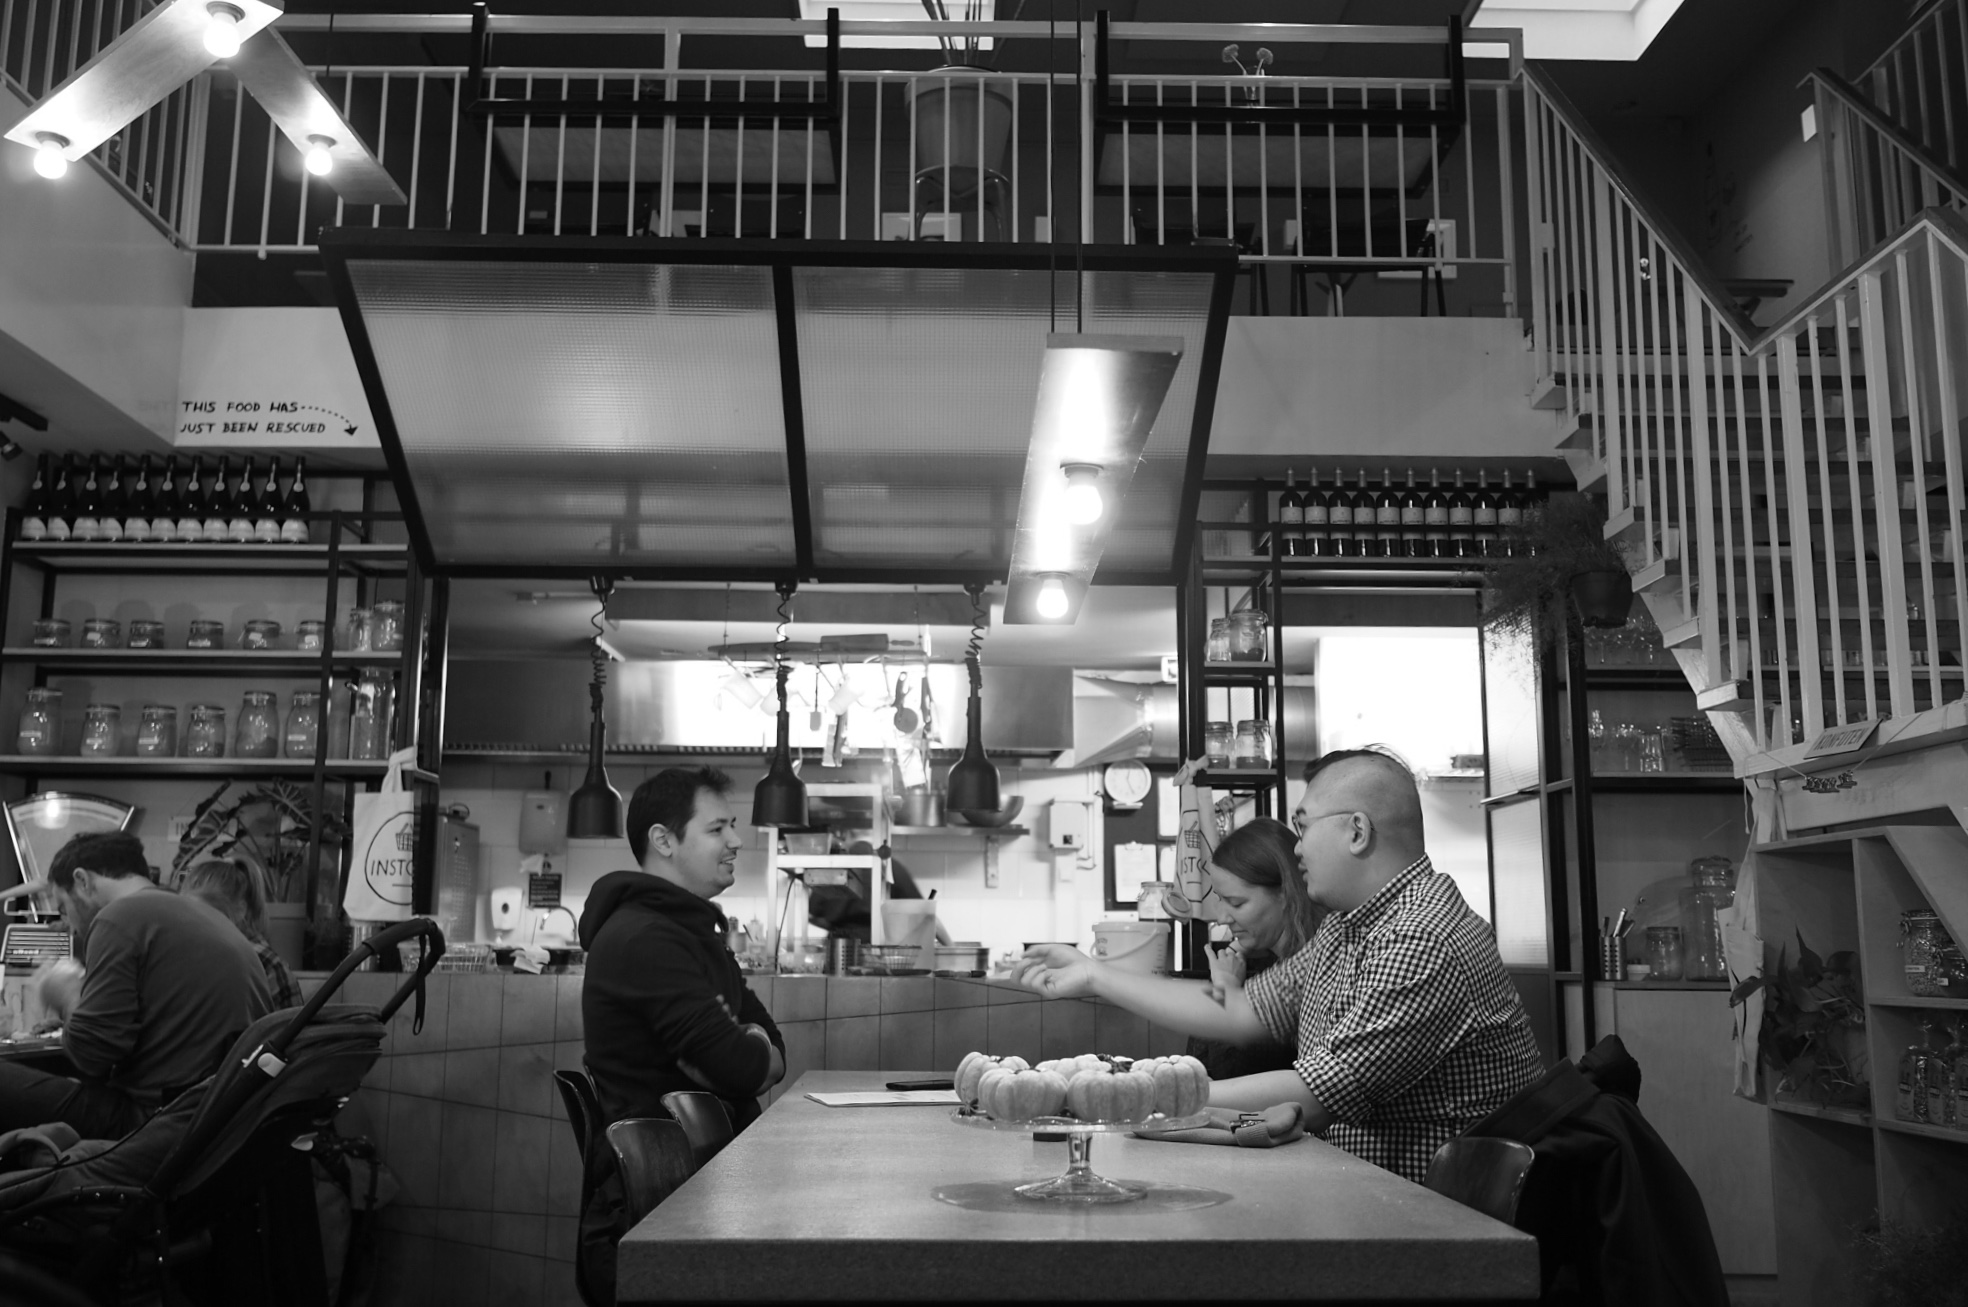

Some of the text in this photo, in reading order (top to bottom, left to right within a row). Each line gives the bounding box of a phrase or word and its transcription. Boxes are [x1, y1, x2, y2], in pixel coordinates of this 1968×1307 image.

[182, 401, 299, 413] THIS FOOD HAS
[180, 422, 326, 434] JUST BEEN RESCUED
